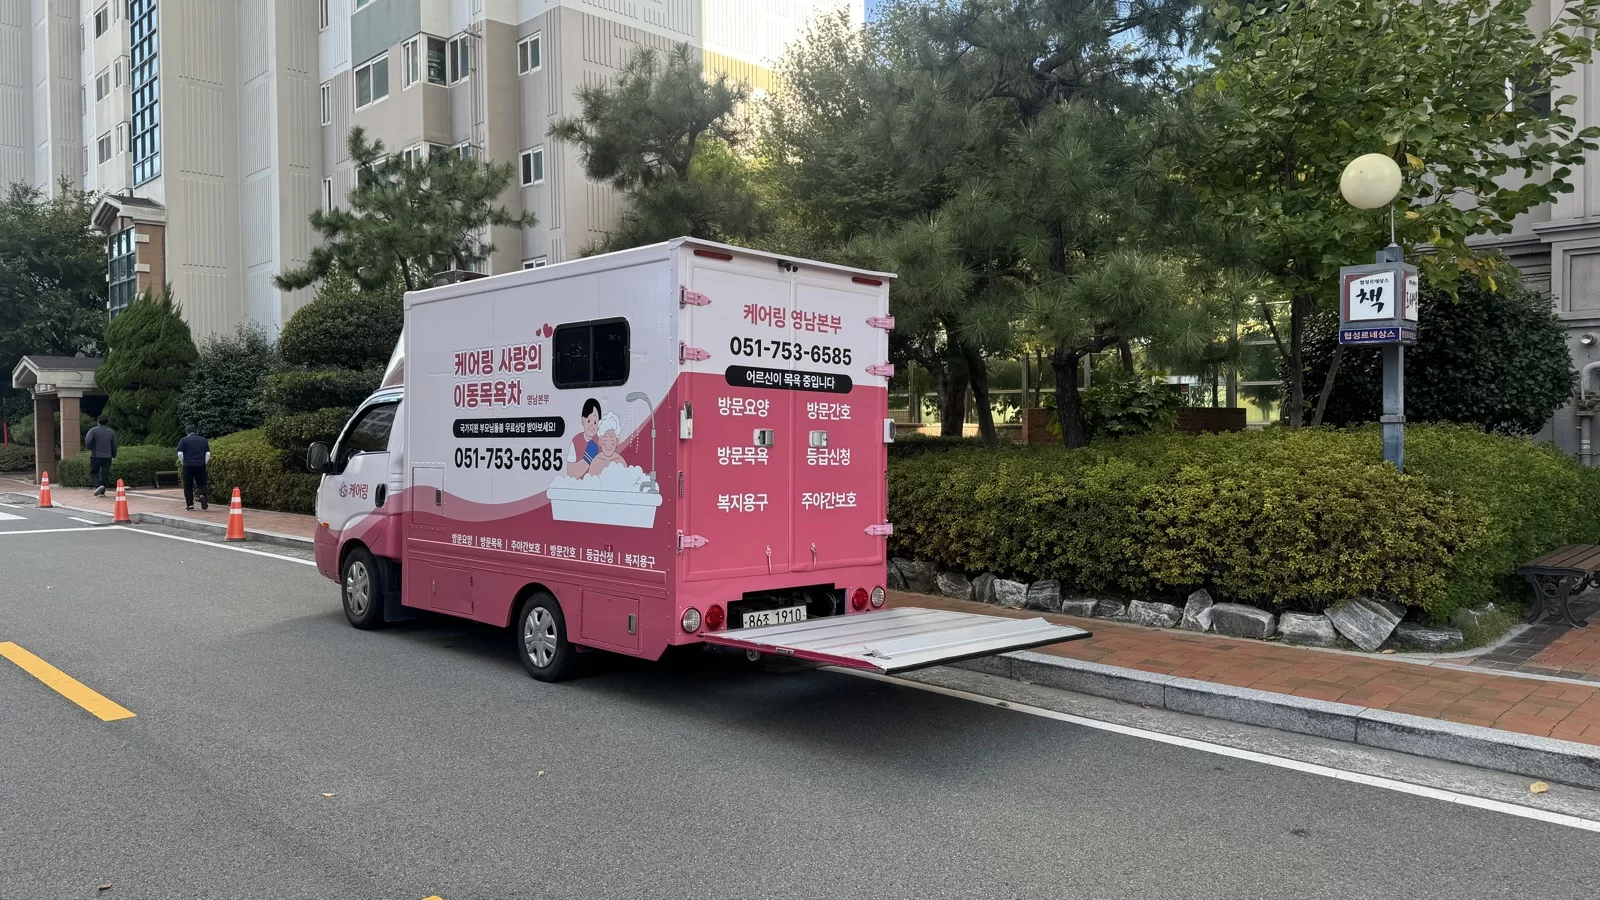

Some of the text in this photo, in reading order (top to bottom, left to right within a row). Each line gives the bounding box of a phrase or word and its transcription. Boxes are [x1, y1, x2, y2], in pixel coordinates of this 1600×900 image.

[1356, 286, 1384, 314] 책
[743, 303, 842, 335] 케어링 영남본부
[1344, 330, 1396, 340] 협성르네상스
[454, 343, 542, 376] 케어링 사랑의
[730, 336, 852, 366] 051-753-6585
[746, 370, 835, 389] 어르신이 목욕 중입니다
[454, 380, 550, 408] 이동목욕차 영남본부
[718, 396, 770, 418] 방문요양
[807, 401, 852, 421] 방문간호
[460, 423, 479, 434] 국가지원
[505, 422, 526, 433] 무료상담
[527, 421, 556, 433] 받아보세요!
[454, 447, 563, 471] 051-753-6585
[717, 446, 769, 466] 방문목욕
[806, 447, 851, 466] 등급신청
[349, 483, 369, 500] 케어링
[801, 491, 857, 511] 주야간보호
[717, 493, 769, 513] 복지용구
[451, 533, 656, 570] 방문요양 방문목욕 주야간보호 방문간호 등급신청 복지용구
[748, 608, 802, 628] 86조 1910
